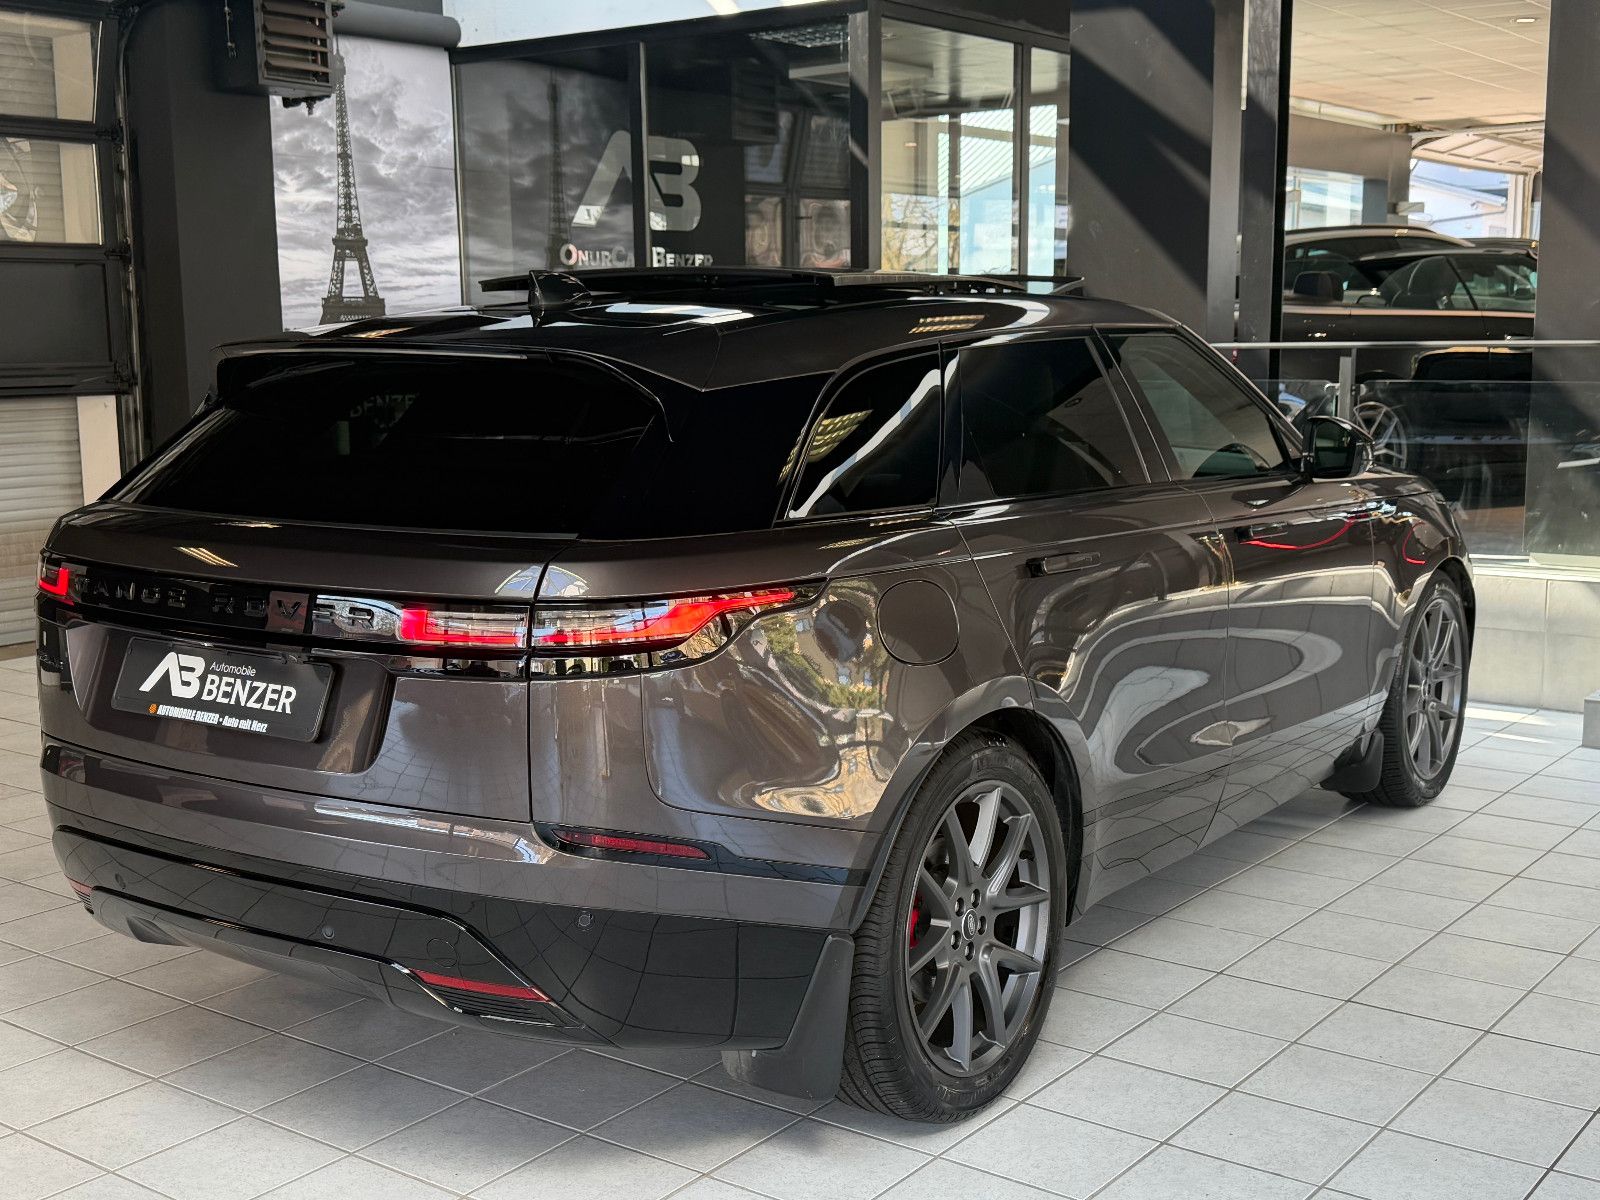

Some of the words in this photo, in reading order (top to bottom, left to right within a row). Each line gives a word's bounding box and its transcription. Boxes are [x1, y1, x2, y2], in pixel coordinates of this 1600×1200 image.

[209, 661, 257, 677] Automobile
[201, 674, 297, 715] BENZER
[156, 704, 197, 721] AUTOMOBILE
[195, 710, 220, 725] BENZER
[222, 715, 239, 728] Auto
[239, 718, 252, 730] mit
[251, 719, 268, 733] Herz
